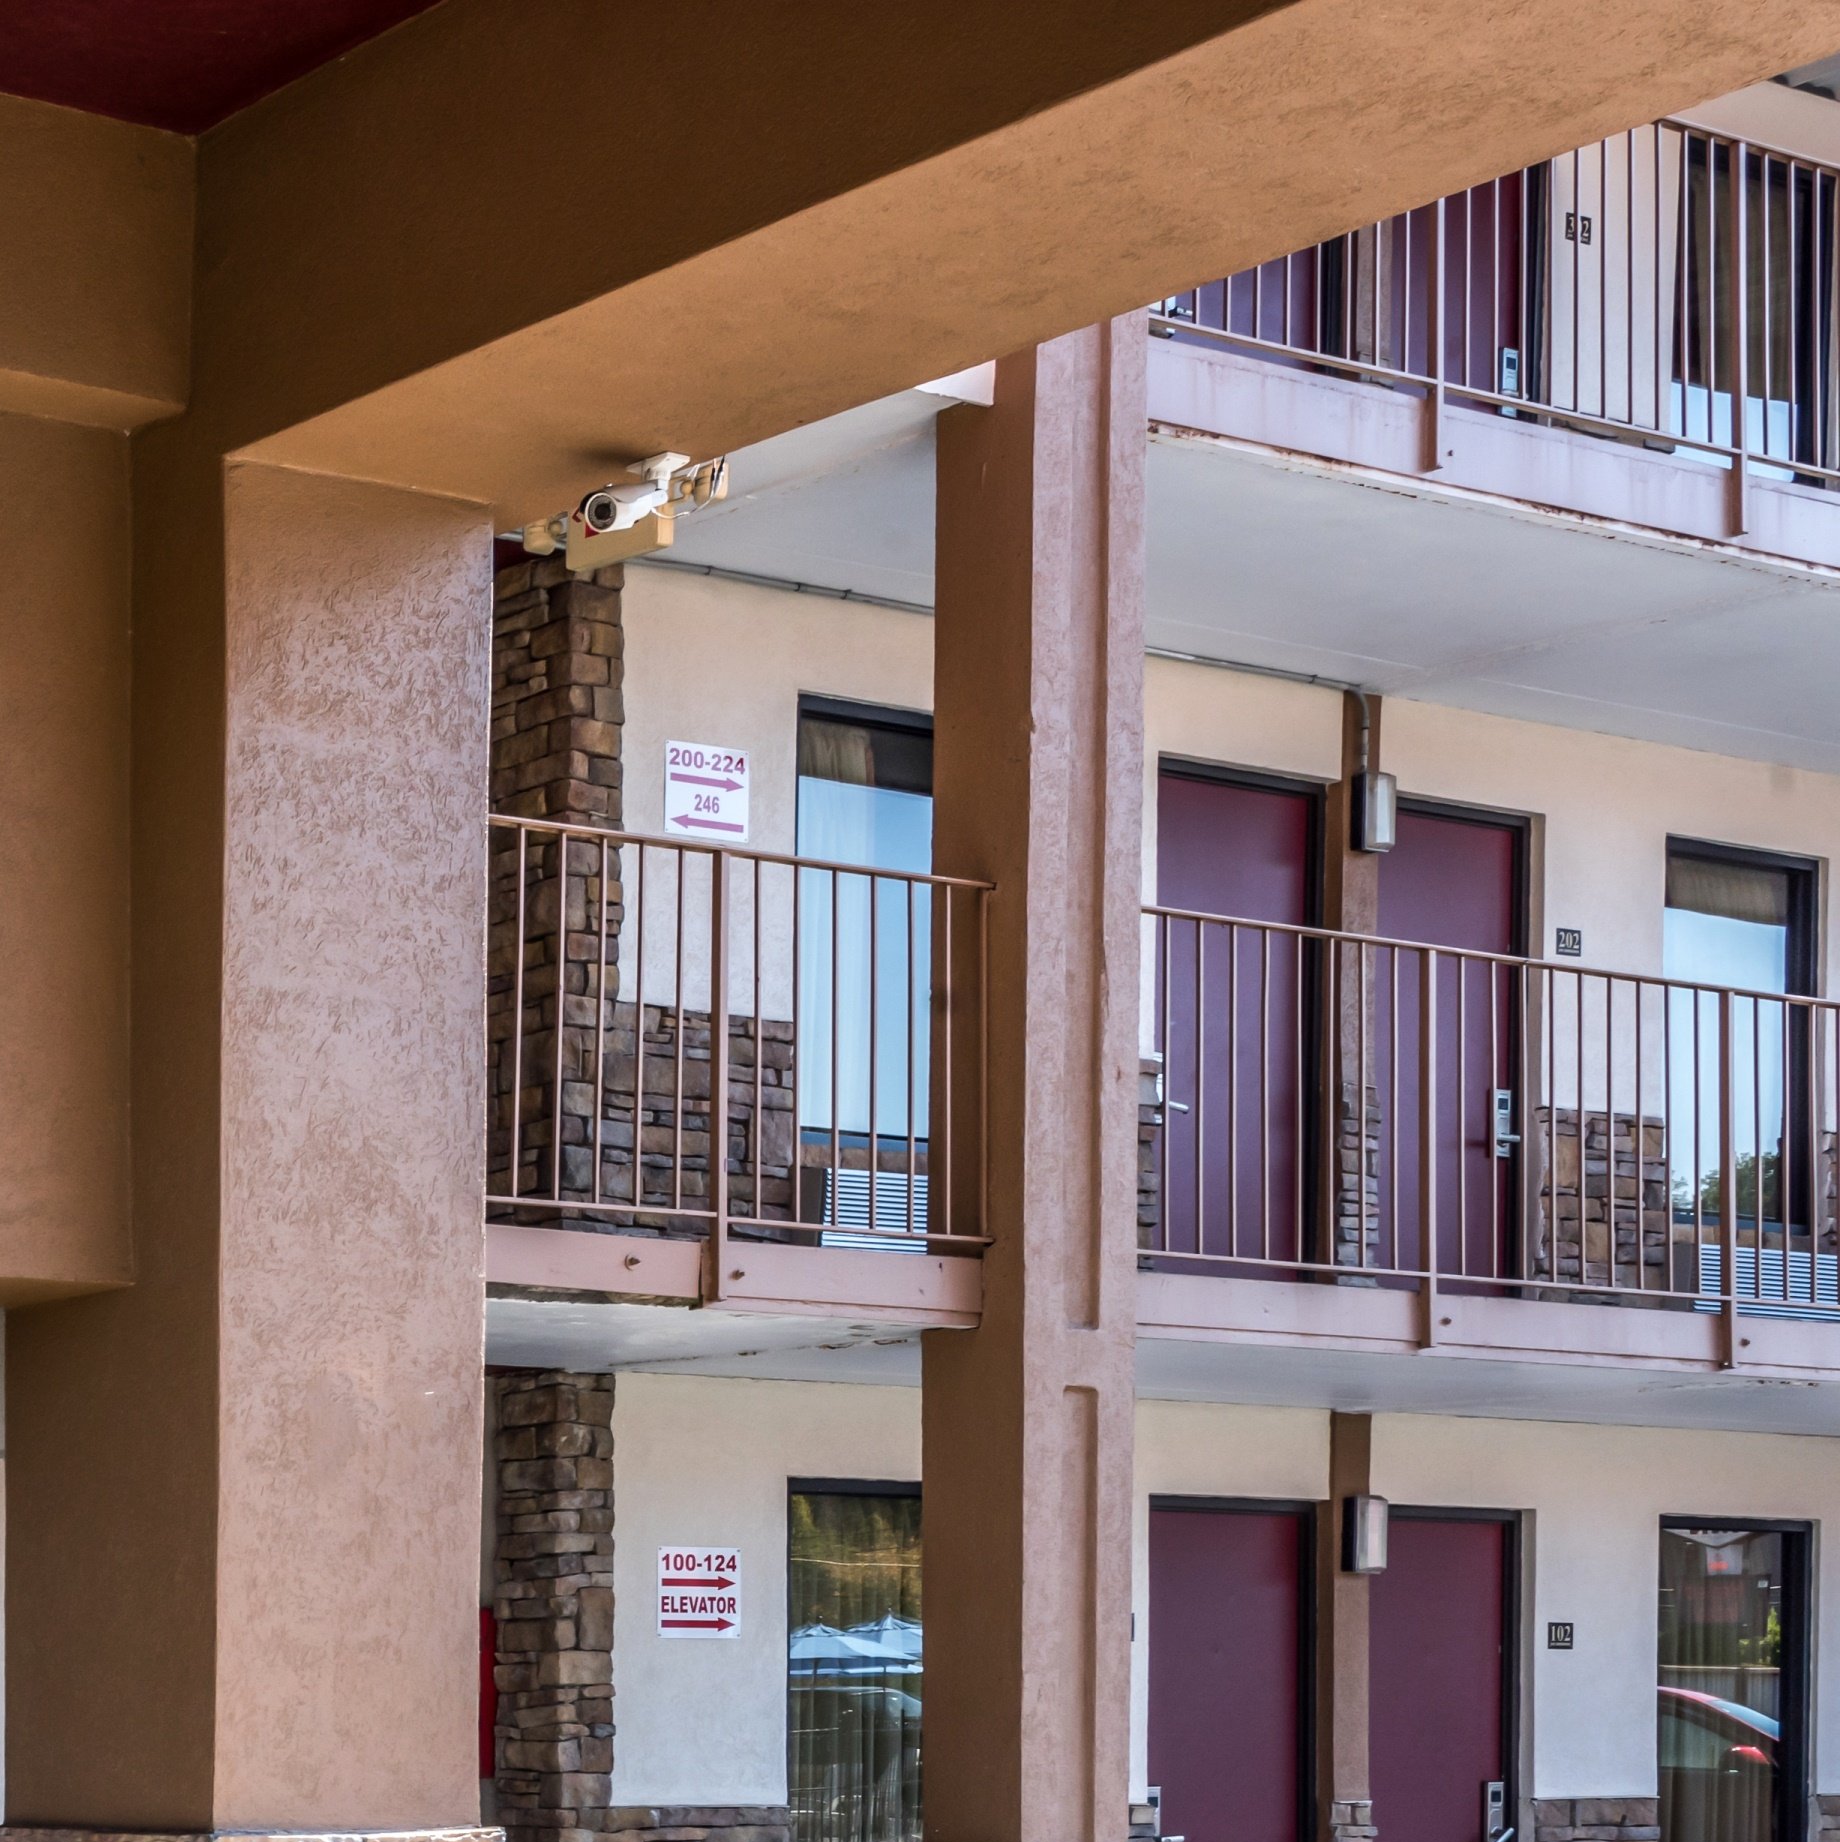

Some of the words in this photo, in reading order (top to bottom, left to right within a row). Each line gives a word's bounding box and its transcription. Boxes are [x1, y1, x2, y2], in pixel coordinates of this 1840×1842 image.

[1567, 217, 1589, 237] 32
[669, 747, 745, 775] 200-224
[694, 794, 720, 814] 246
[1558, 931, 1580, 949] 202
[662, 1553, 737, 1572] 100-124
[661, 1596, 736, 1614] ELEVATOR
[1551, 1625, 1571, 1642] 102
